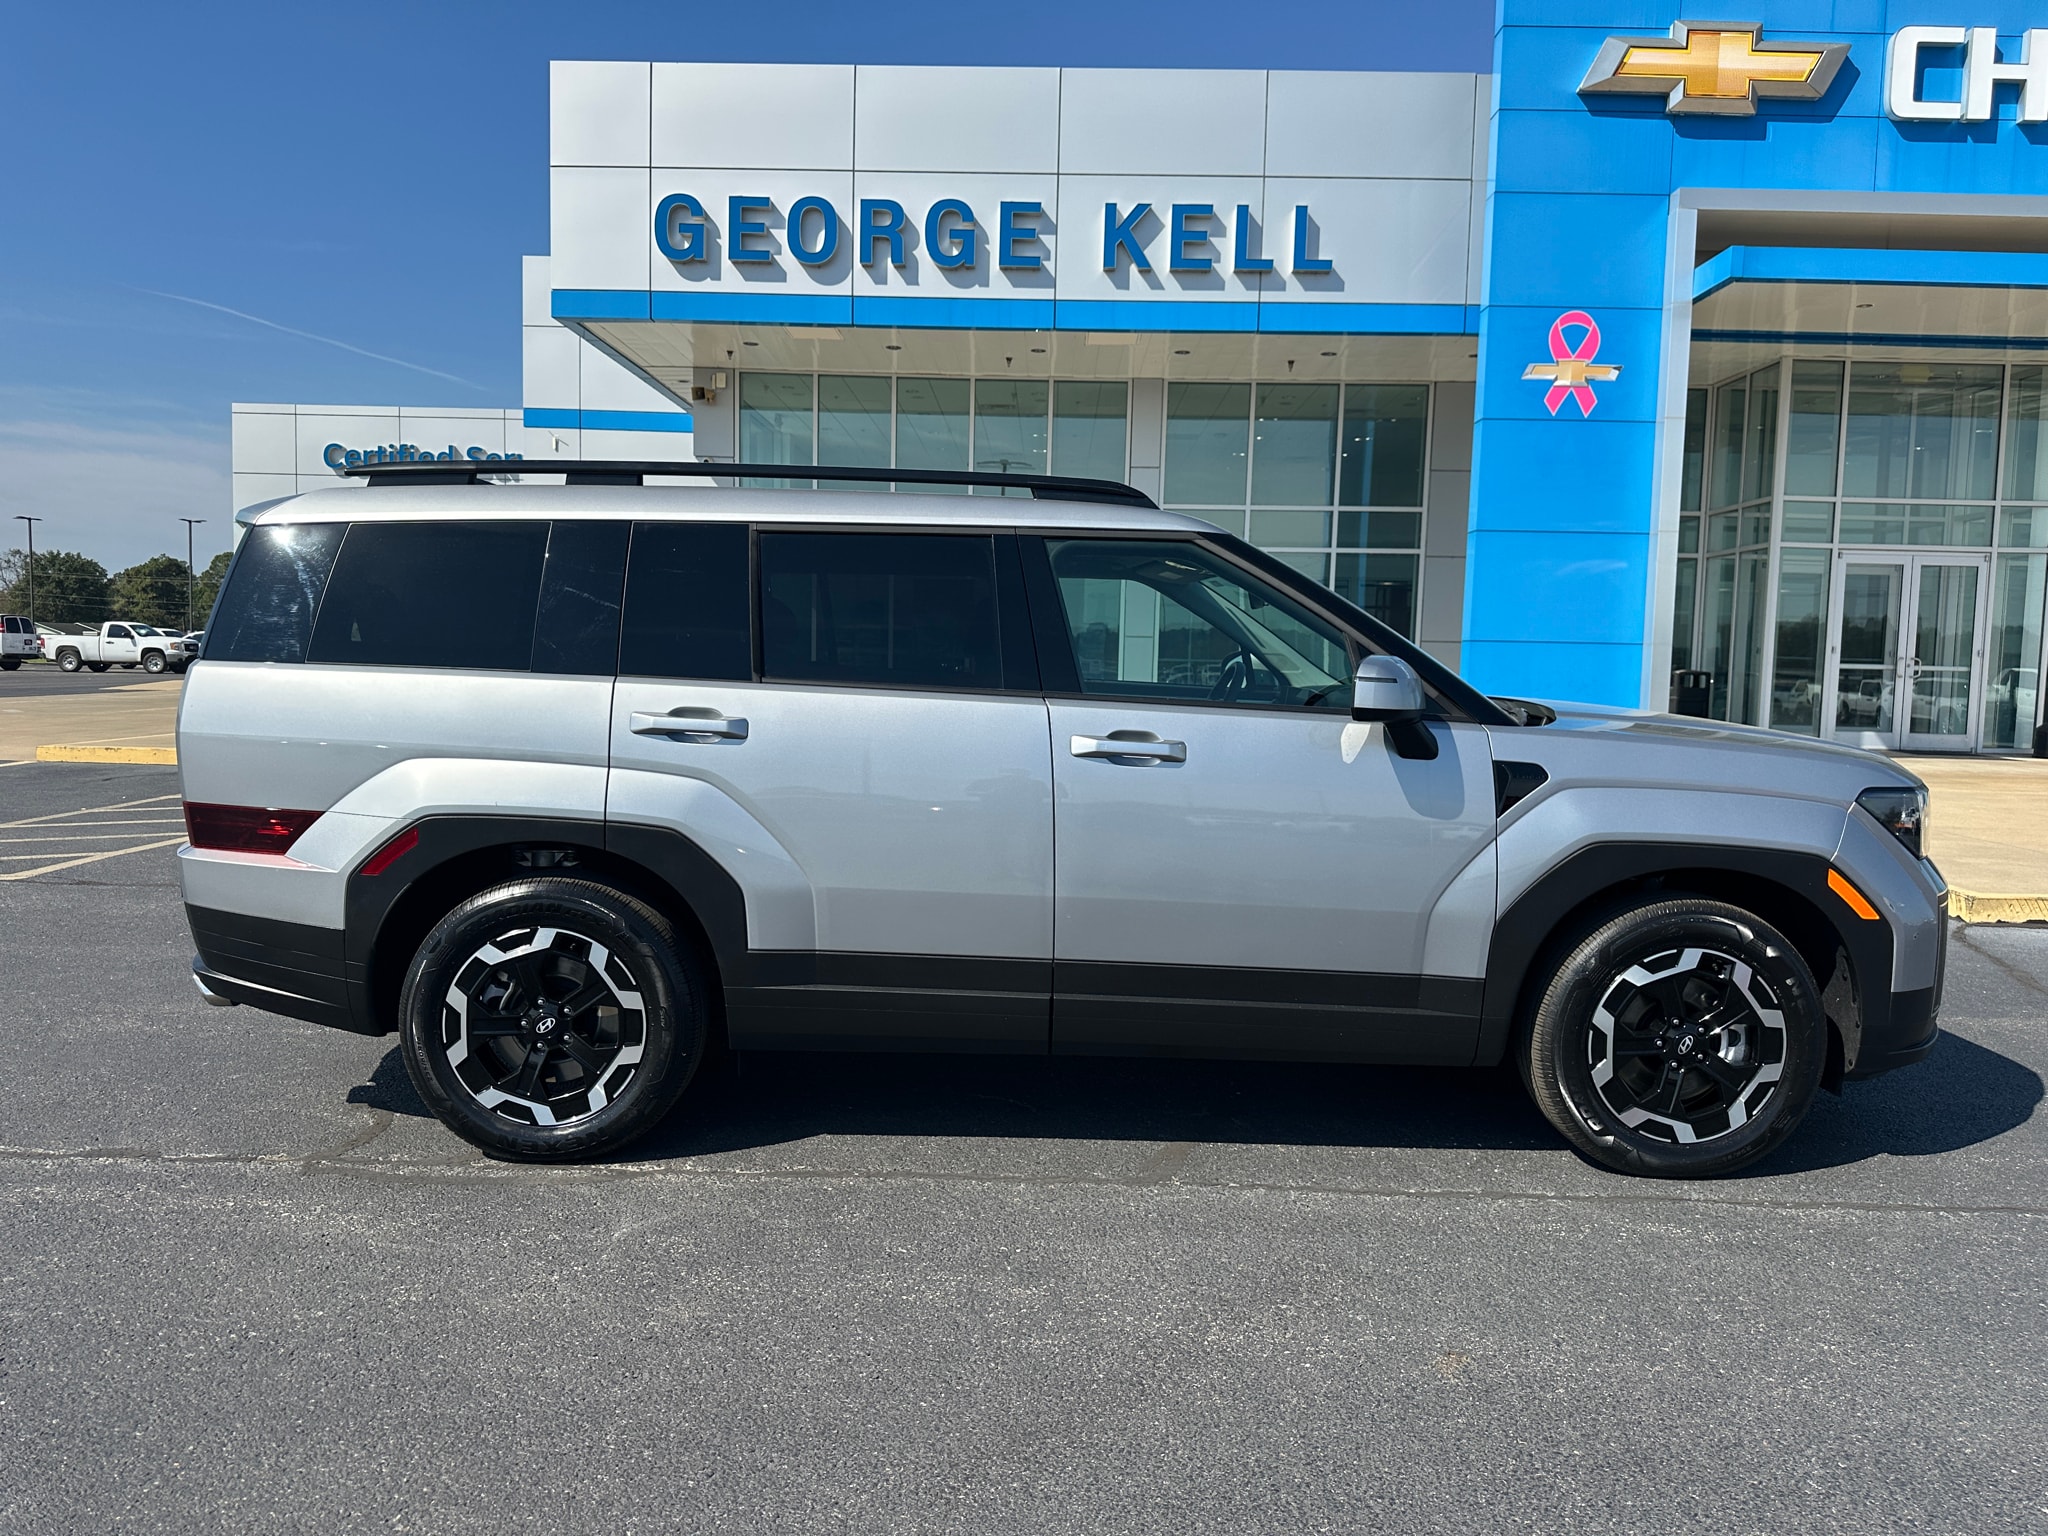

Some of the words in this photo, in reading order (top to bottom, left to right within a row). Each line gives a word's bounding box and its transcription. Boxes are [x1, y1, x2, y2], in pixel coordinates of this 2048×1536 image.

[654, 193, 1043, 269] GEORGE
[1103, 202, 1334, 273] KELL
[496, 1127, 609, 1154] NEXEN
